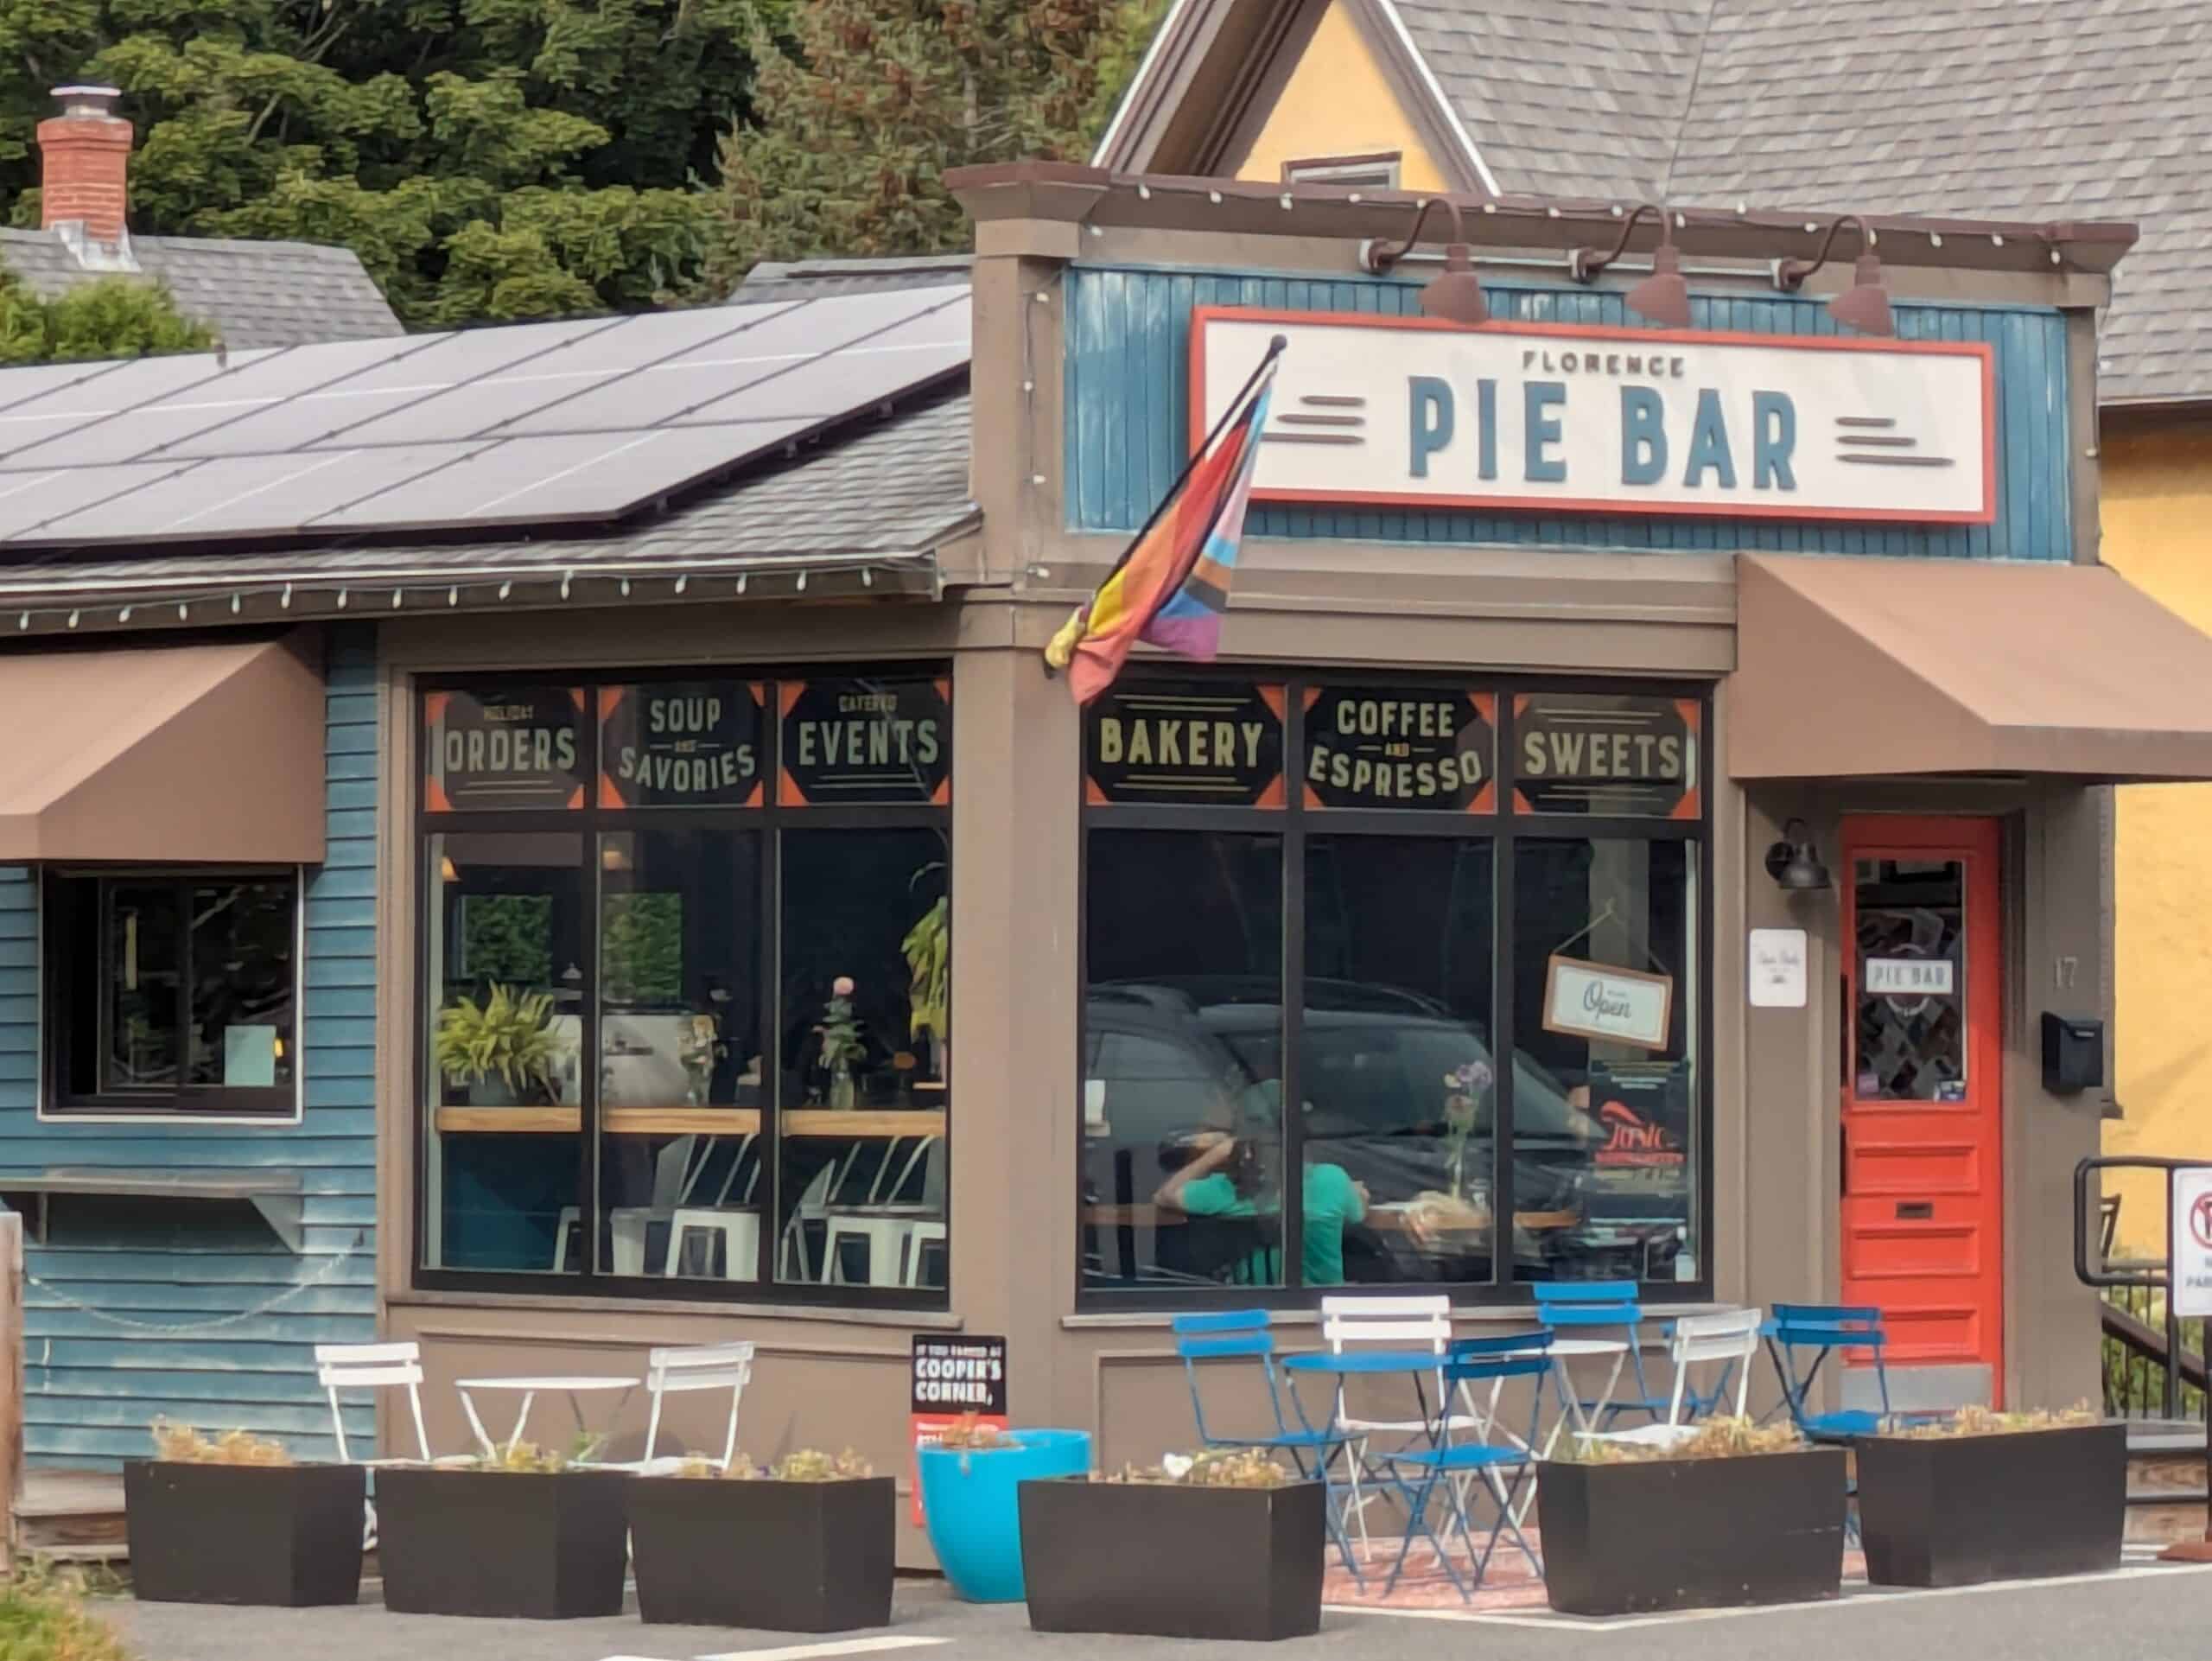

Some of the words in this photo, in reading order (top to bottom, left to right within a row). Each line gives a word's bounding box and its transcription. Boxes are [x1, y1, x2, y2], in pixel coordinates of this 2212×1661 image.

[1522, 350, 1684, 379] FLORENCE
[1408, 375, 1567, 484] PIE
[1619, 385, 1797, 492] BAR
[650, 697, 721, 732] SOUP
[1337, 700, 1455, 738] COFFEE
[445, 728, 576, 773] ORDERS
[798, 719, 939, 766] EVENTS
[1100, 717, 1263, 768] BAKERY
[1523, 731, 1681, 778] SWEETS
[619, 744, 755, 792] SAVORIES
[1308, 745, 1482, 798] ESPRESSO
[1583, 980, 1632, 1021] Open
[915, 1358, 1002, 1381] COOPER'S
